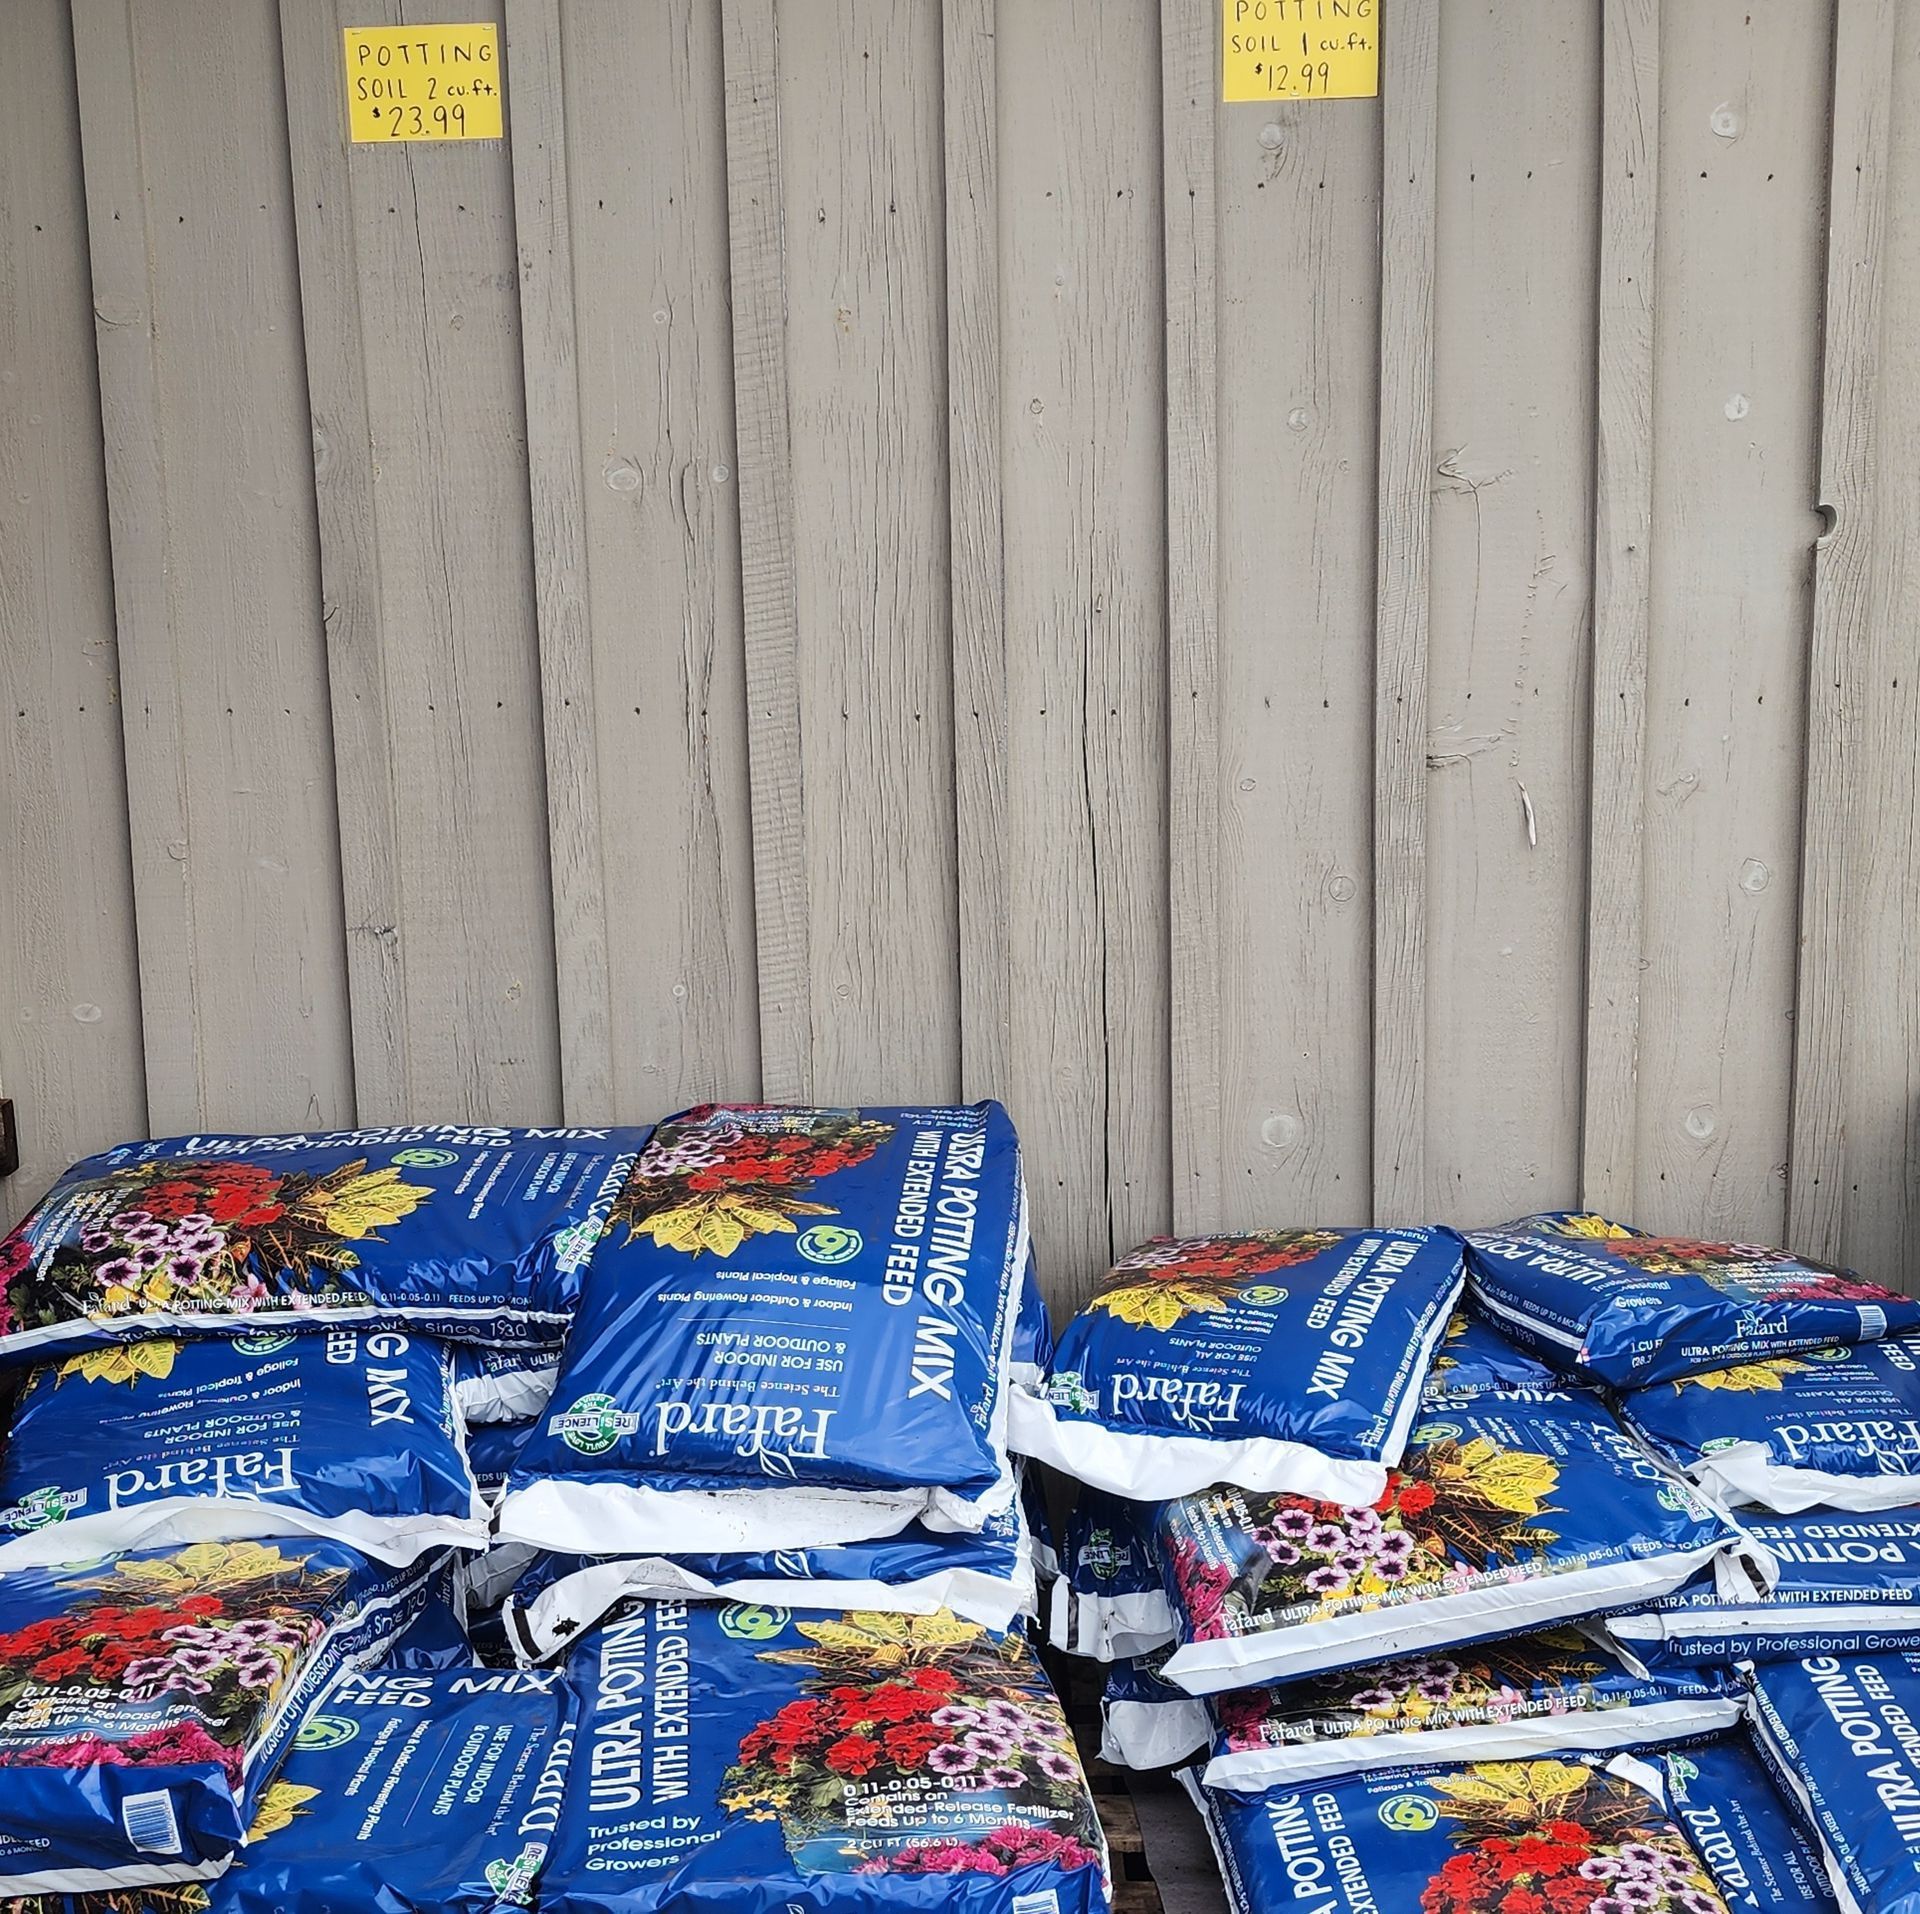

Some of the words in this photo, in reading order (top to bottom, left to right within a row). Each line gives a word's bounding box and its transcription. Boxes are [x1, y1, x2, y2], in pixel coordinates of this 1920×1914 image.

[1236, 0, 1371, 22] POTTING
[358, 42, 491, 66] POTTING
[1232, 35, 1280, 53] SOIL
[1302, 32, 1308, 57] 1
[1255, 62, 1329, 94] $12.99
[357, 77, 407, 101] SOIL
[427, 77, 437, 100] 2
[372, 104, 465, 137] $23.99
[436, 1135, 513, 1147] FEED
[524, 1128, 612, 1141] MIX
[911, 1130, 942, 1157] WITH
[940, 1128, 987, 1180] ULTRA
[894, 1160, 935, 1238] EXTENDED
[923, 1185, 979, 1307] POTTING
[1370, 1241, 1422, 1272] ULTRA
[716, 1270, 749, 1282] Plants
[752, 1271, 798, 1285] Tropical
[813, 1276, 857, 1291] Foliage
[882, 1244, 920, 1307] FEED
[1323, 1256, 1370, 1296] EXTENDED
[226, 1297, 249, 1309] MIX
[251, 1296, 278, 1308] WITH
[281, 1292, 339, 1306] EXTENDED
[342, 1291, 368, 1302] FEED
[381, 1293, 440, 1302] 0.11-0.05-0.11
[449, 1294, 476, 1304] FEEDS
[478, 1295, 491, 1304] UP
[493, 1295, 505, 1304] TO
[658, 1292, 691, 1303] Plants
[693, 1290, 748, 1304] Flowering
[751, 1294, 800, 1307] Outdoor
[813, 1298, 853, 1312] Indoor
[1305, 1297, 1338, 1329] FEED
[1330, 1275, 1396, 1348] POTTING
[1734, 1315, 1789, 1337] Fafard
[696, 1332, 750, 1346] PLANTS
[754, 1334, 831, 1353] OUTDOOR
[1169, 1337, 1207, 1348] PLANTS
[1208, 1341, 1263, 1353] OUTDOOR
[1681, 1347, 1710, 1357] ULTRA
[1711, 1341, 1750, 1354] POTTING
[1751, 1340, 1769, 1350] MIX
[713, 1351, 777, 1367] INDOOR
[782, 1356, 812, 1370] FOR
[816, 1359, 843, 1372] USE
[908, 1315, 958, 1402] MIX
[1215, 1352, 1237, 1361] FOR
[1878, 1344, 1916, 1371] FEED
[255, 1358, 299, 1379] Foliage
[1306, 1350, 1355, 1400] MIX
[197, 1376, 242, 1395] Tropical
[263, 1378, 301, 1398] Indoor
[686, 1378, 705, 1389] the
[710, 1379, 756, 1392] Behind
[761, 1381, 809, 1396] Science
[813, 1385, 839, 1398] The
[1111, 1374, 1247, 1422] Fafard
[204, 1411, 286, 1429] OUTDOOR
[237, 1423, 268, 1435] FOR
[272, 1419, 301, 1431] USE
[555, 1417, 630, 1429] RESILIENCE
[143, 1422, 200, 1439] PLANTS
[164, 1429, 232, 1445] INDOOR
[655, 1402, 837, 1459] Fafard
[1773, 1421, 1920, 1460] Fafard
[103, 1447, 302, 1509] Fafard
[1803, 1523, 1920, 1539] XTENDED
[1760, 1541, 1906, 1562] POTTIN
[1282, 1604, 1320, 1622] ULTRA
[1324, 1594, 1379, 1611] POTTING
[1382, 1589, 1407, 1604] MIX
[1411, 1583, 1440, 1597] WITH
[1442, 1566, 1510, 1589] EXTENDED
[1512, 1561, 1541, 1575] FEED
[1558, 1549, 1624, 1567] 0.11-0.05-0.11
[1632, 1541, 1662, 1553] FEEDS
[1779, 1590, 1810, 1603] WITH
[1812, 1588, 1880, 1602] EXTENDED
[1882, 1588, 1913, 1601] FEED
[1731, 1639, 1751, 1655] by
[1757, 1635, 1859, 1653] Professional
[449, 1667, 565, 1694] MIX
[653, 1635, 688, 1738] EXTENDED
[1854, 1664, 1896, 1700] FEED
[22, 1684, 155, 1700] 0.11-0.05-0.11
[334, 1691, 432, 1707] FEED
[14, 1698, 90, 1710] Contains
[93, 1701, 116, 1710] an
[1801, 1657, 1894, 1757] POTTING
[1, 1719, 50, 1730] Feeds
[55, 1715, 78, 1726] Up
[83, 1715, 100, 1724] to
[104, 1721, 113, 1731] 6
[118, 1718, 180, 1733] Months
[1260, 1719, 1315, 1740] Fafard
[1324, 1720, 1360, 1734] ULTRA
[1366, 1714, 1420, 1731] POTTING
[1426, 1711, 1449, 1725] MIX
[1453, 1707, 1484, 1722] WITH
[1486, 1700, 1553, 1718] EXTENDED
[1556, 1696, 1587, 1709] FEED
[1602, 1689, 1667, 1703] 0.11-0.05-0.11
[498, 1725, 513, 1739] USE
[529, 1725, 548, 1742] The
[450, 1733, 483, 1779] OUTDOOR
[490, 1738, 505, 1757] FOR
[390, 1745, 416, 1775] Outdoor
[515, 1743, 539, 1773] Science
[589, 1711, 642, 1812] ULTRA
[464, 1757, 496, 1803] INDOOR
[653, 1744, 688, 1805] WITH
[344, 1774, 366, 1796] Plants
[367, 1776, 401, 1813] Flowering
[501, 1774, 525, 1804] Behind
[432, 1778, 463, 1816] PLANTS
[844, 1791, 921, 1806] Contains
[924, 1791, 948, 1801] an
[495, 1805, 511, 1820] the
[845, 1801, 1003, 1816] Extended-Release
[1007, 1802, 1074, 1820] Fertilizer
[1312, 1793, 1346, 1832] FEED
[356, 1814, 380, 1840] Plants
[588, 1816, 666, 1841] Trusted
[673, 1815, 701, 1832] by
[847, 1816, 899, 1827] Feeds
[903, 1816, 927, 1828] Up
[932, 1813, 949, 1824] to
[955, 1813, 965, 1824] 6
[970, 1813, 1031, 1829] Months
[1821, 1811, 1838, 1832] FEEDS
[1833, 1832, 1844, 1843] UP
[1839, 1845, 1850, 1855] TO
[847, 1839, 857, 1849] 2
[860, 1839, 883, 1850] CU
[887, 1838, 900, 1848] FT
[906, 1837, 945, 1849] (56.6
[586, 1853, 680, 1872] Growers
[1783, 1851, 1797, 1866] ALL
[1790, 1868, 1808, 1883] FOR
[1801, 1884, 1815, 1899] USE
